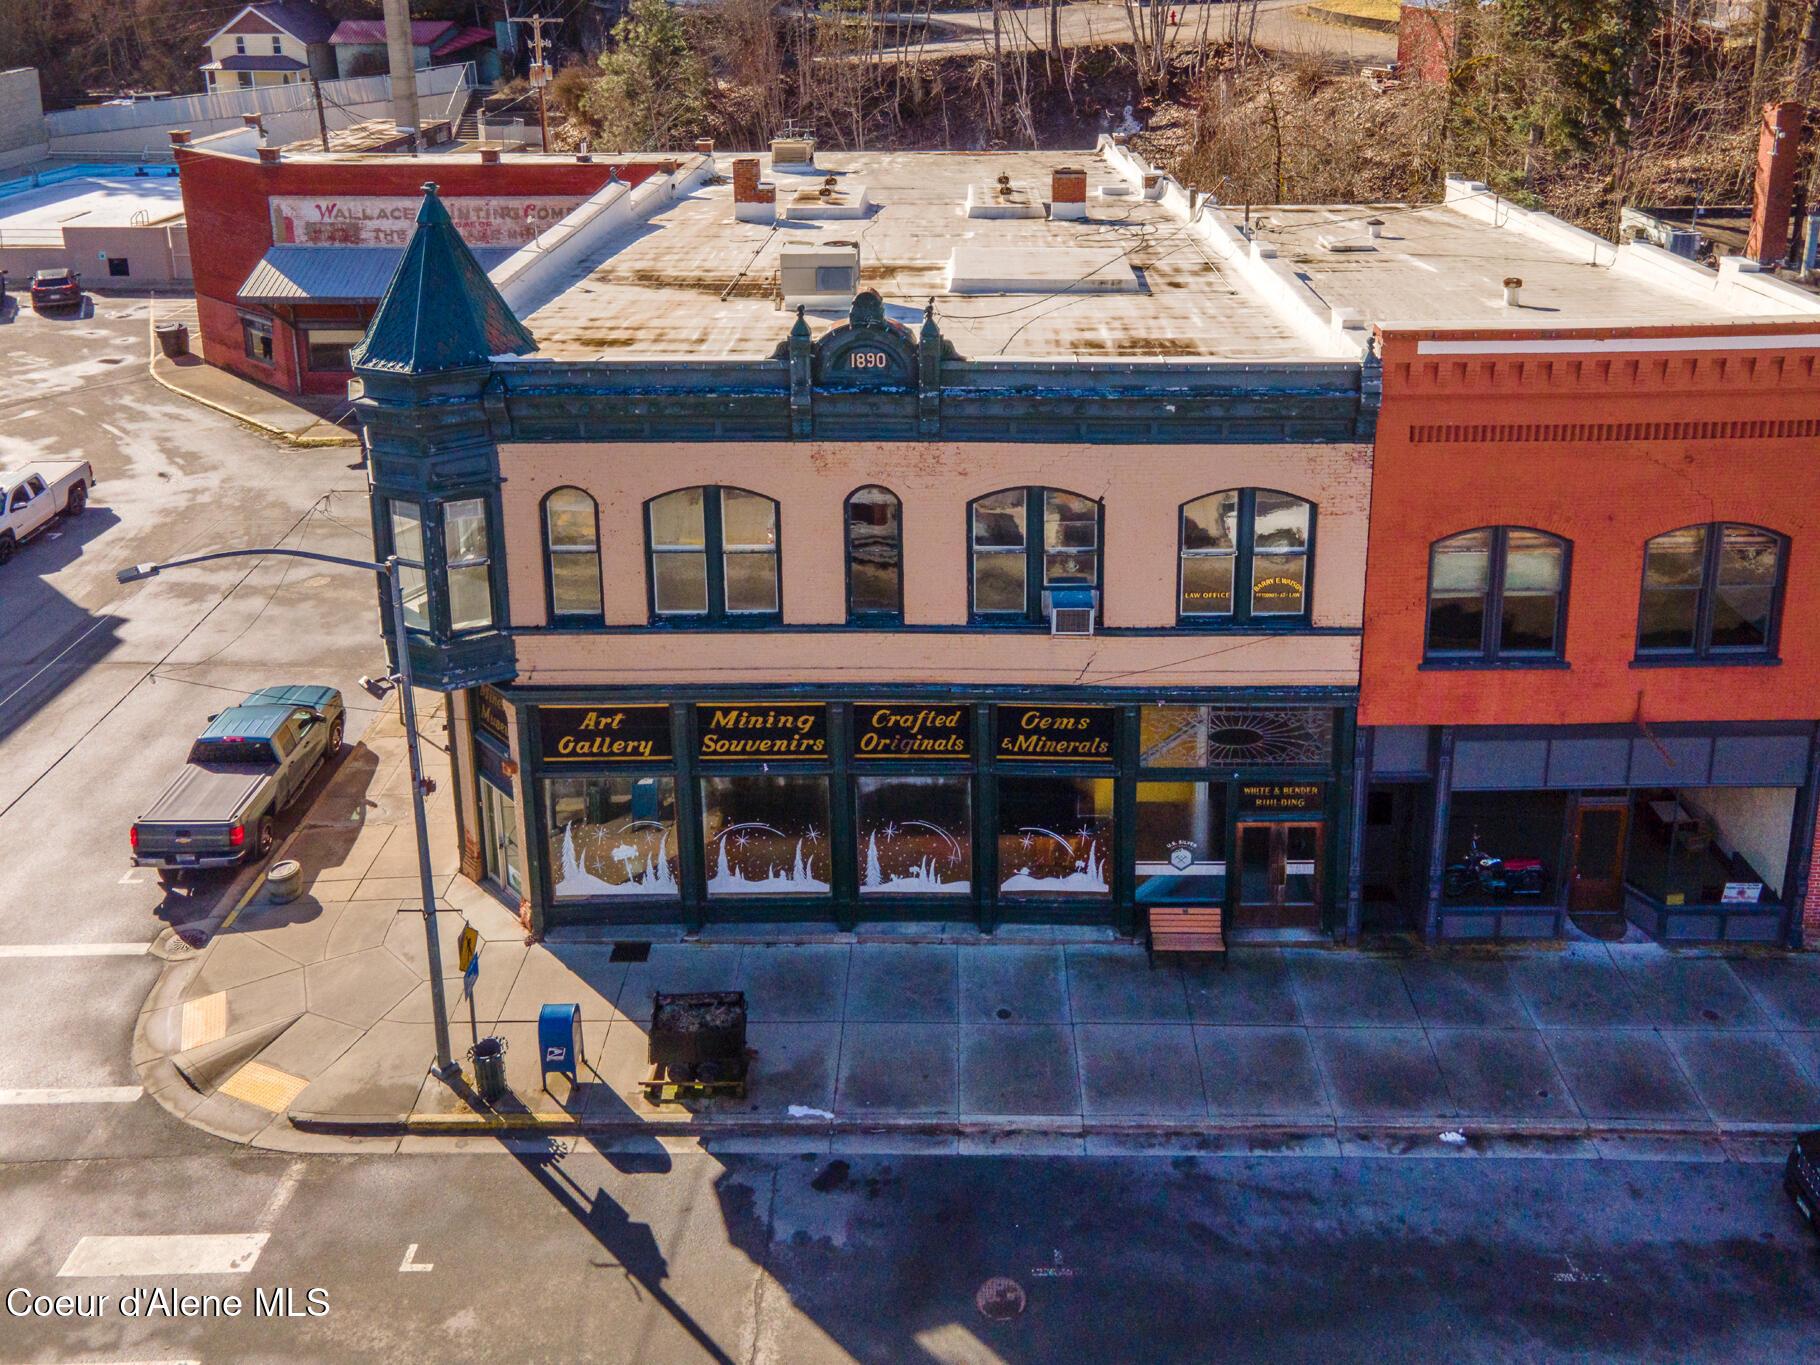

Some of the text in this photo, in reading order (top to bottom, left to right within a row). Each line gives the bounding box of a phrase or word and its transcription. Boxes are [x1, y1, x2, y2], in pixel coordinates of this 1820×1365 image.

[315, 203, 416, 220] WALLACE
[851, 353, 886, 368] 1890
[578, 711, 627, 730] Art
[710, 710, 816, 733] Mining
[871, 709, 961, 733] Crafted
[1021, 711, 1091, 730] Gems
[558, 735, 653, 757] Gallery
[702, 734, 825, 752] Souvenirs
[860, 732, 965, 753] Originals
[1243, 786, 1318, 795] WHITE & BENDER
